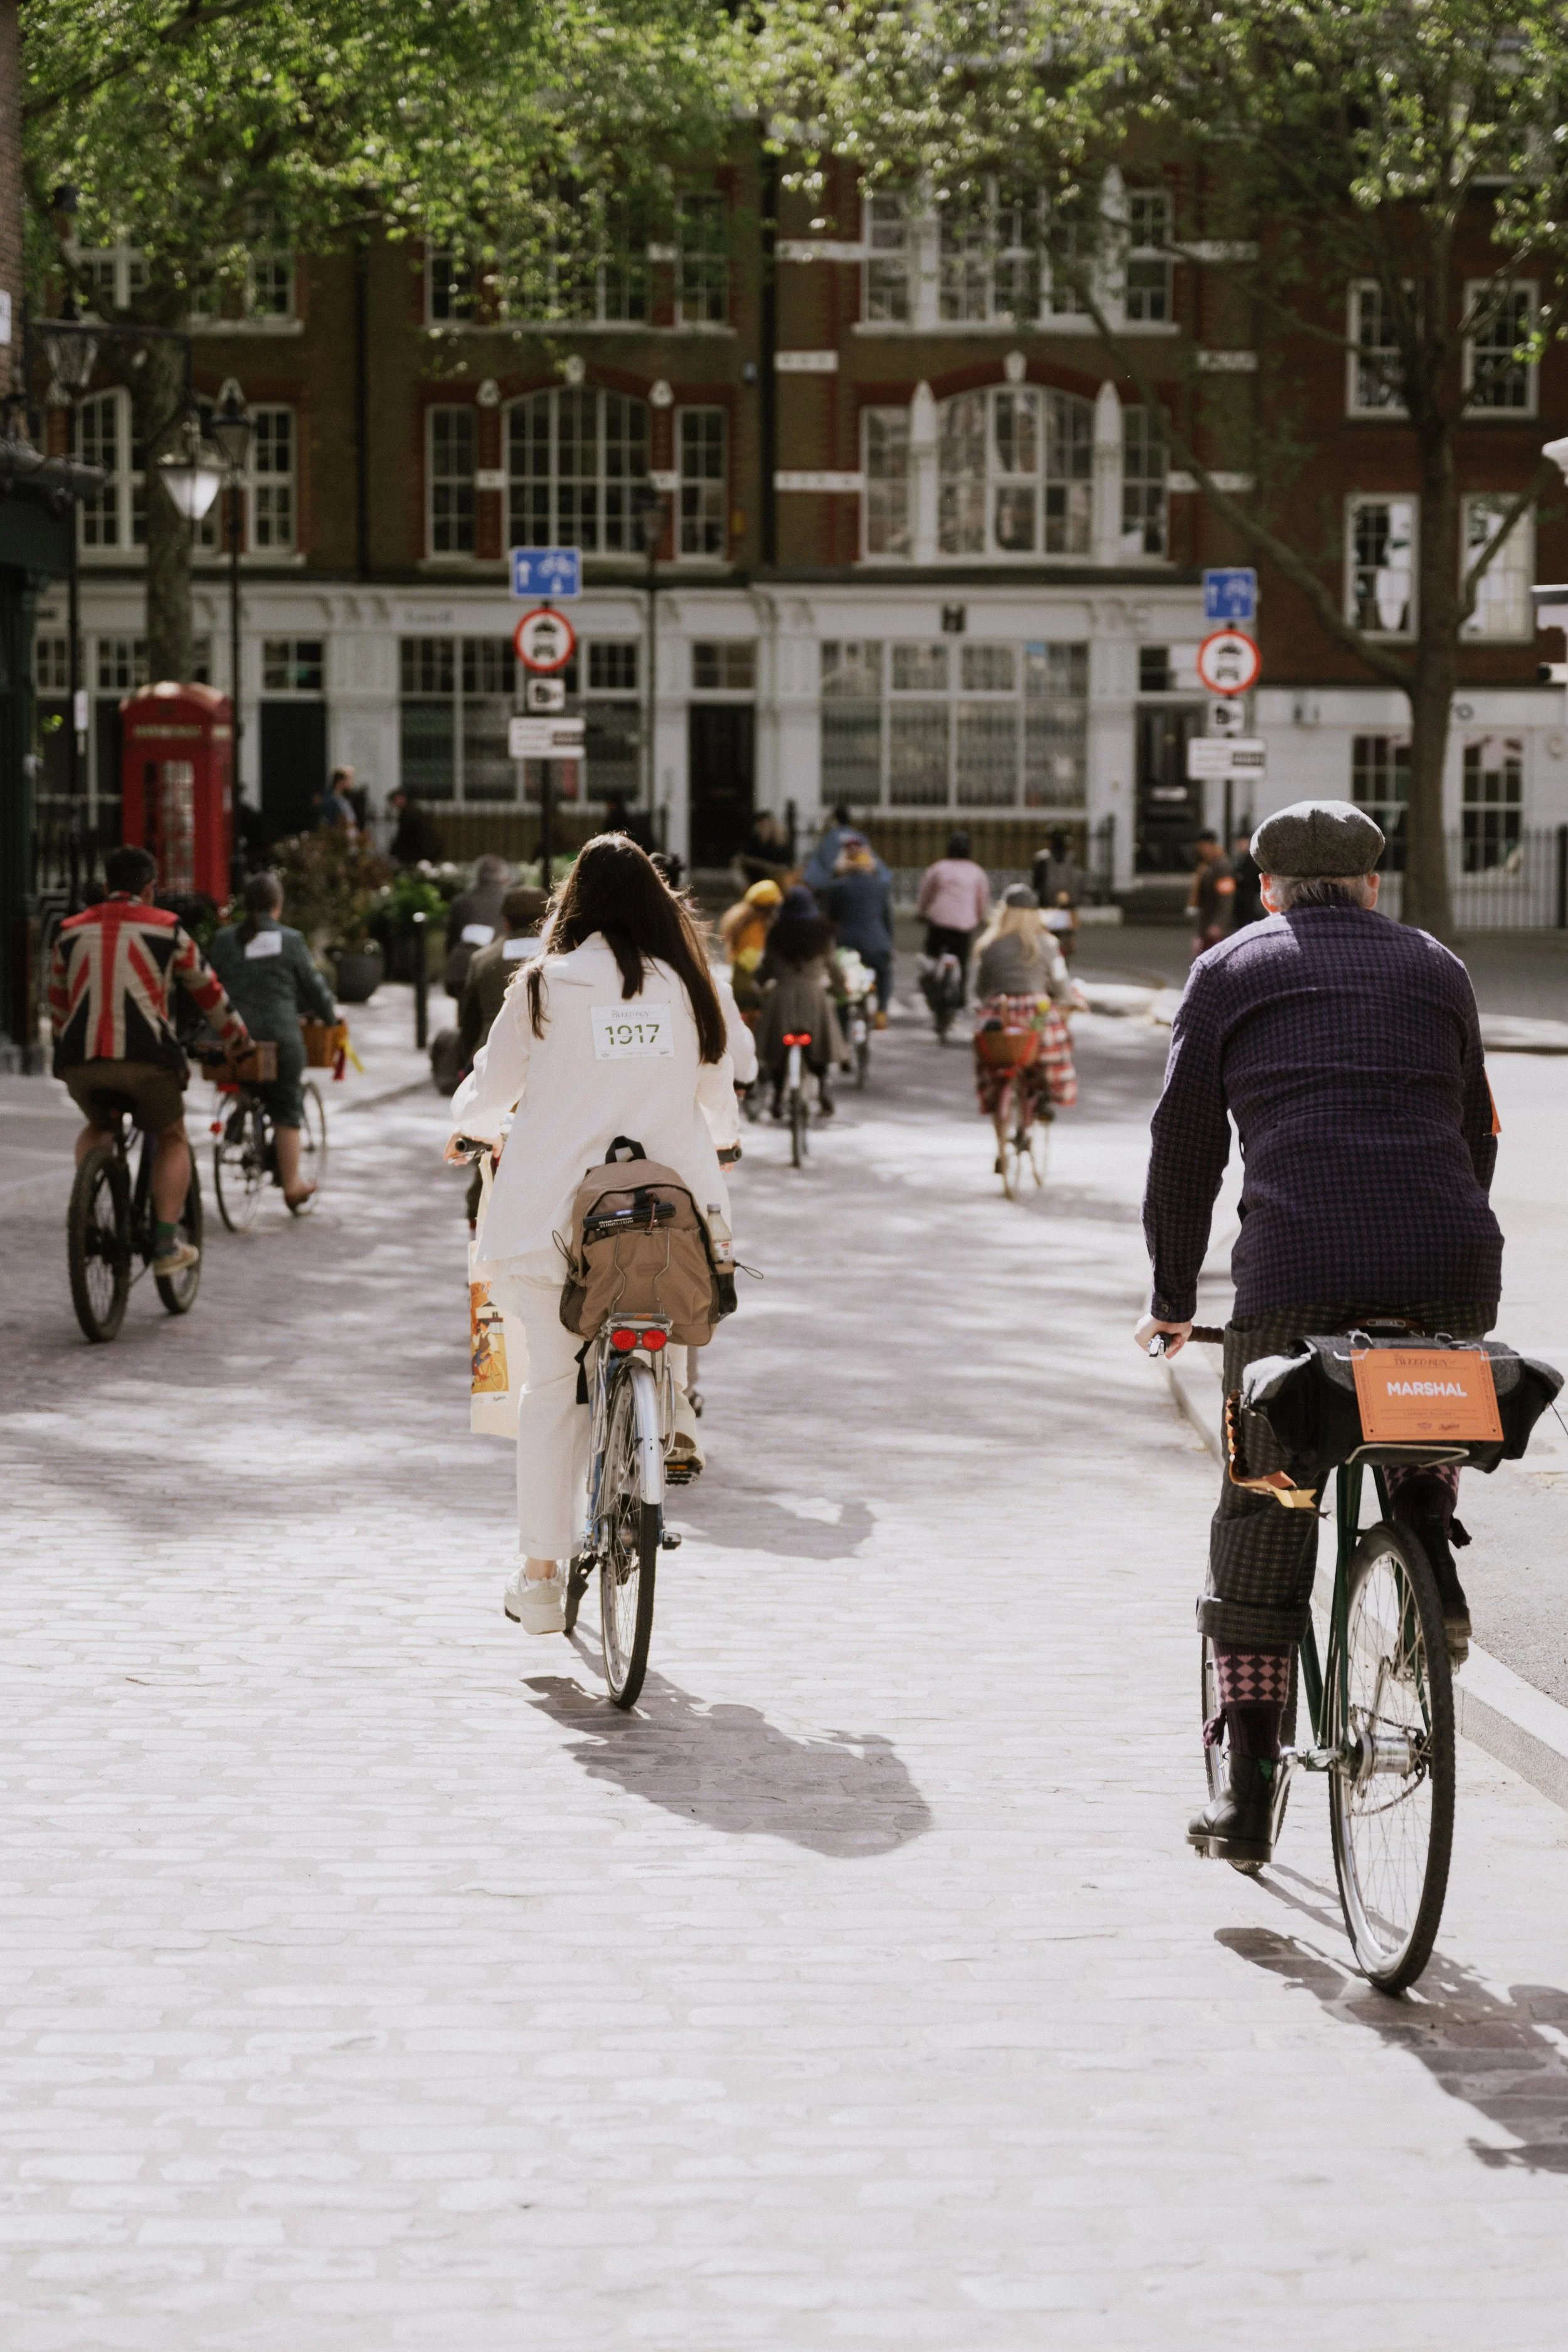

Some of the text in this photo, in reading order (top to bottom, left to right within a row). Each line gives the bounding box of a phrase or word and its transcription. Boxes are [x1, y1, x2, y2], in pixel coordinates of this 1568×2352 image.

[605, 1024, 660, 1045] 1917
[600, 1219, 634, 1228] KRYPTONITE
[1386, 1381, 1467, 1397] MARSHAL
